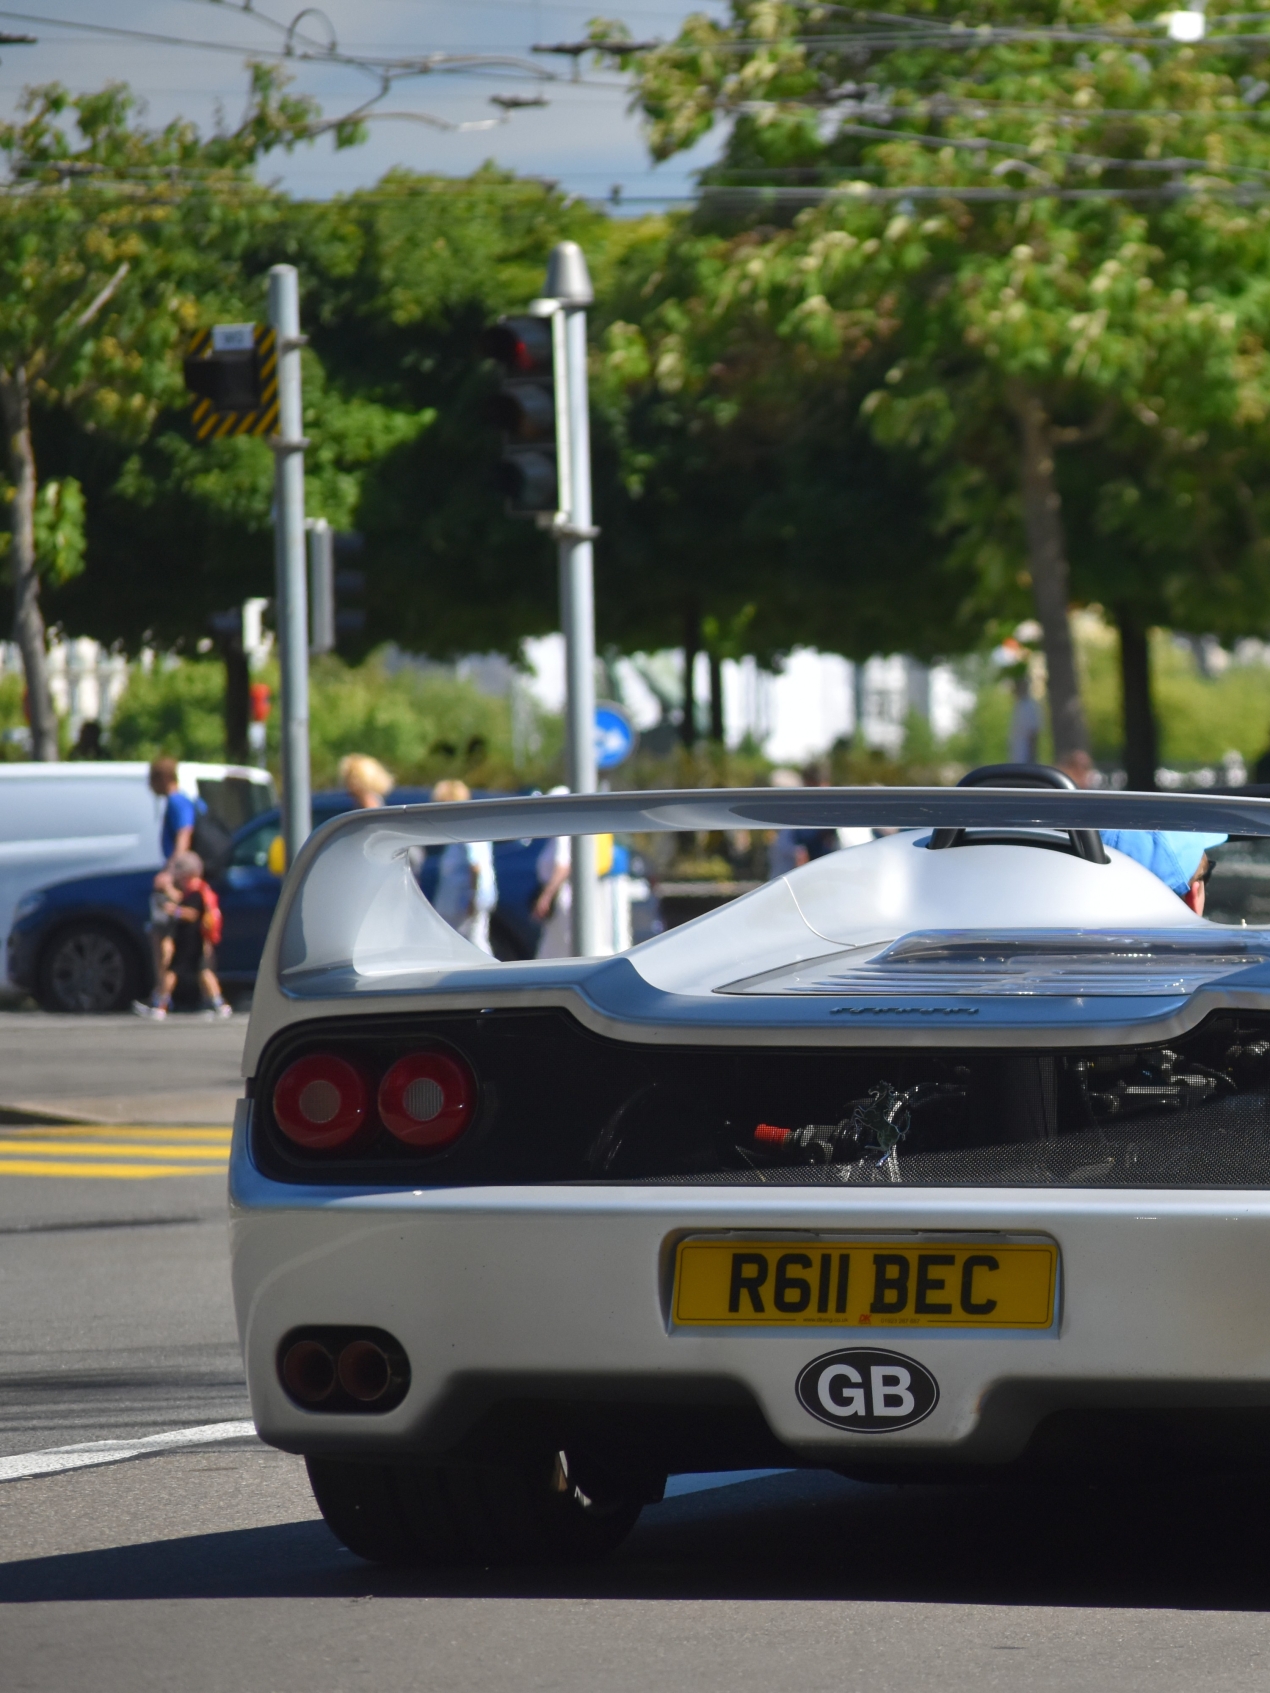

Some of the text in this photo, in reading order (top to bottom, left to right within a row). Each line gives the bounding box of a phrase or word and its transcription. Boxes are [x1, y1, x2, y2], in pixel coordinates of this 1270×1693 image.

[728, 1253, 1000, 1315] R611 BEC
[817, 1364, 915, 1417] GB
